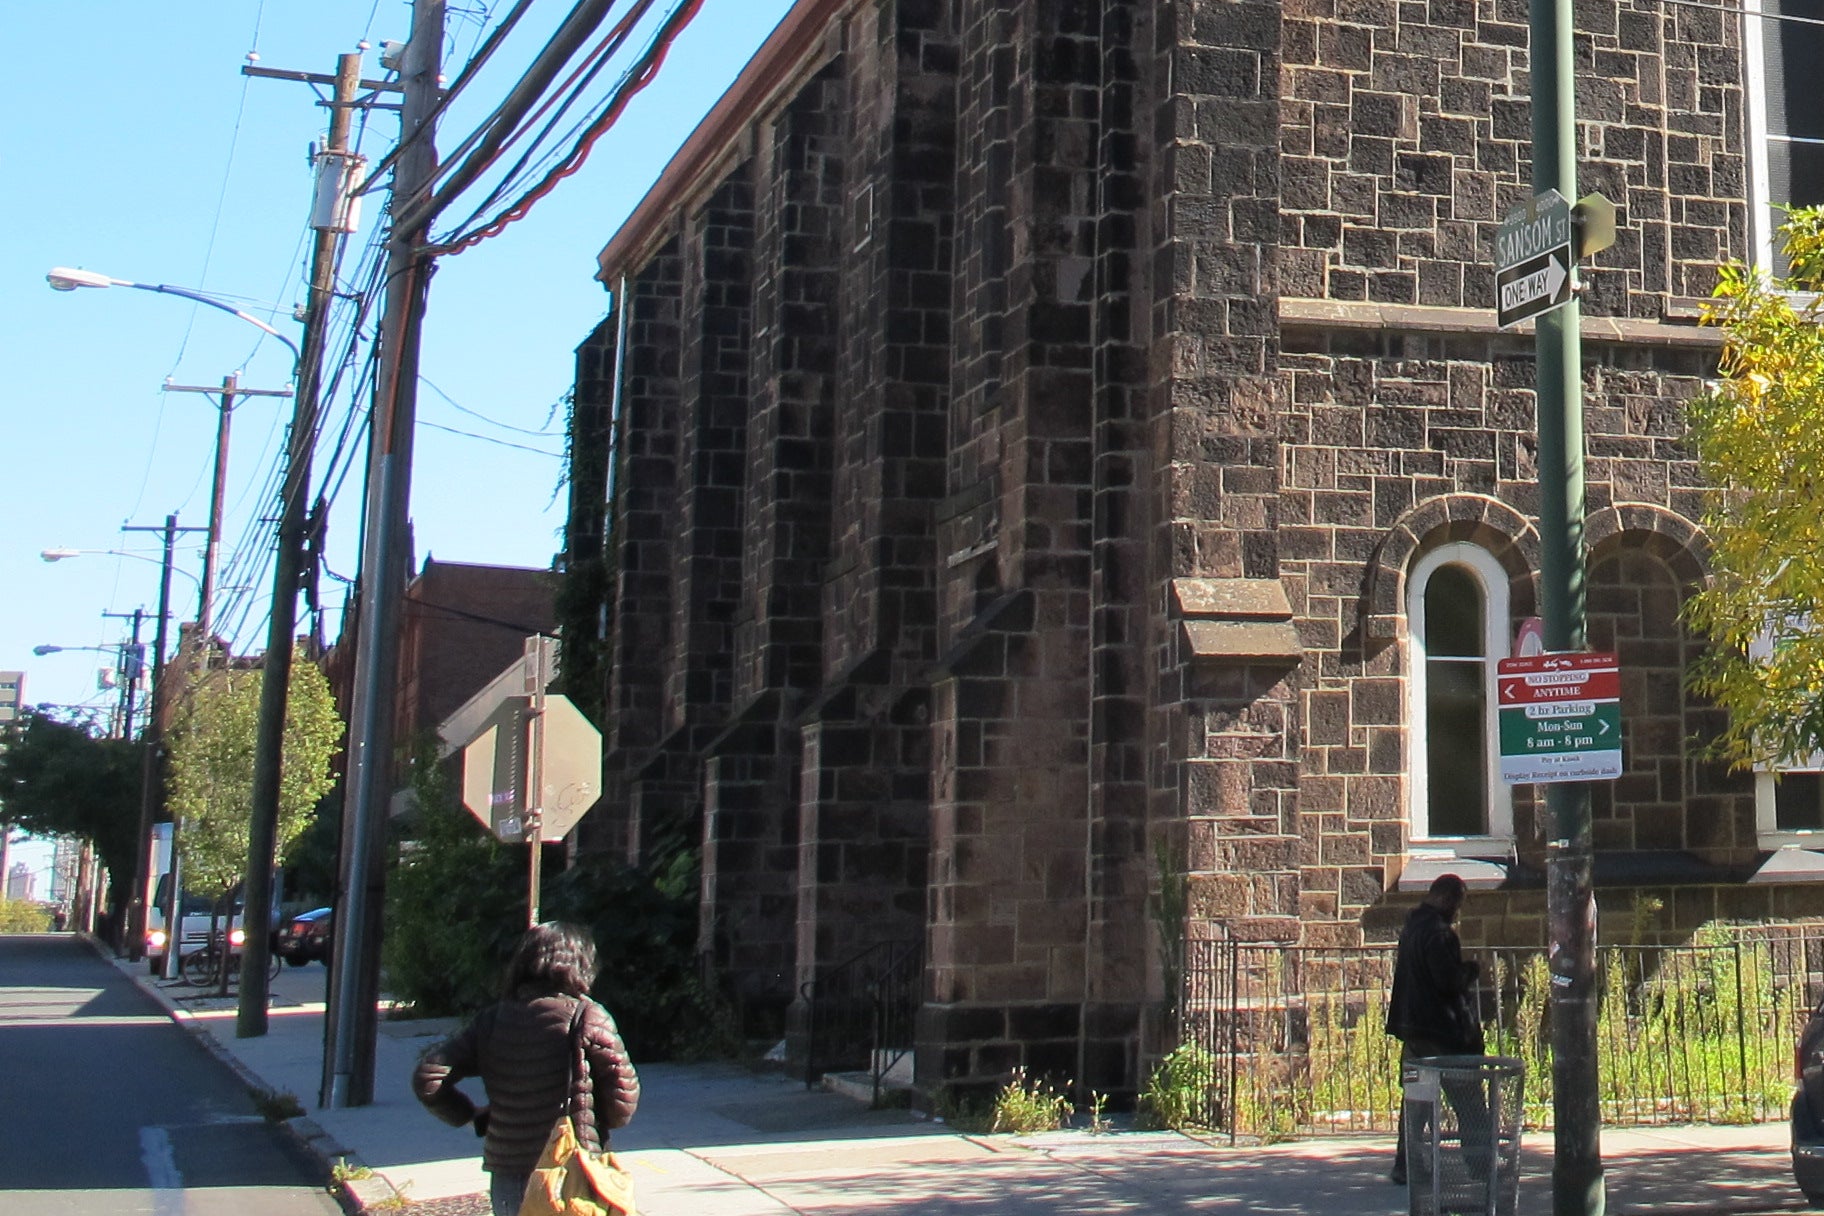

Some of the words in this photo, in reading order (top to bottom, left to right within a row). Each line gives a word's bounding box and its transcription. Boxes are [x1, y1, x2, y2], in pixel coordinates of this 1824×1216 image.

[1499, 215, 1552, 267] SANSOM
[1556, 217, 1567, 242] ST
[1504, 281, 1525, 308] ONE
[1527, 270, 1549, 298] WAY
[1527, 675, 1542, 685] NO
[1543, 672, 1587, 684] STOPPING
[1533, 686, 1581, 698] ANYTIME
[1530, 706, 1537, 716] 2
[1538, 705, 1550, 715] hr
[1552, 703, 1592, 716] Parking
[1537, 719, 1583, 733] Mon-Sun
[1527, 736, 1534, 748] 8
[1536, 738, 1555, 747] am
[1564, 734, 1572, 746] 8
[1574, 736, 1593, 749] pm
